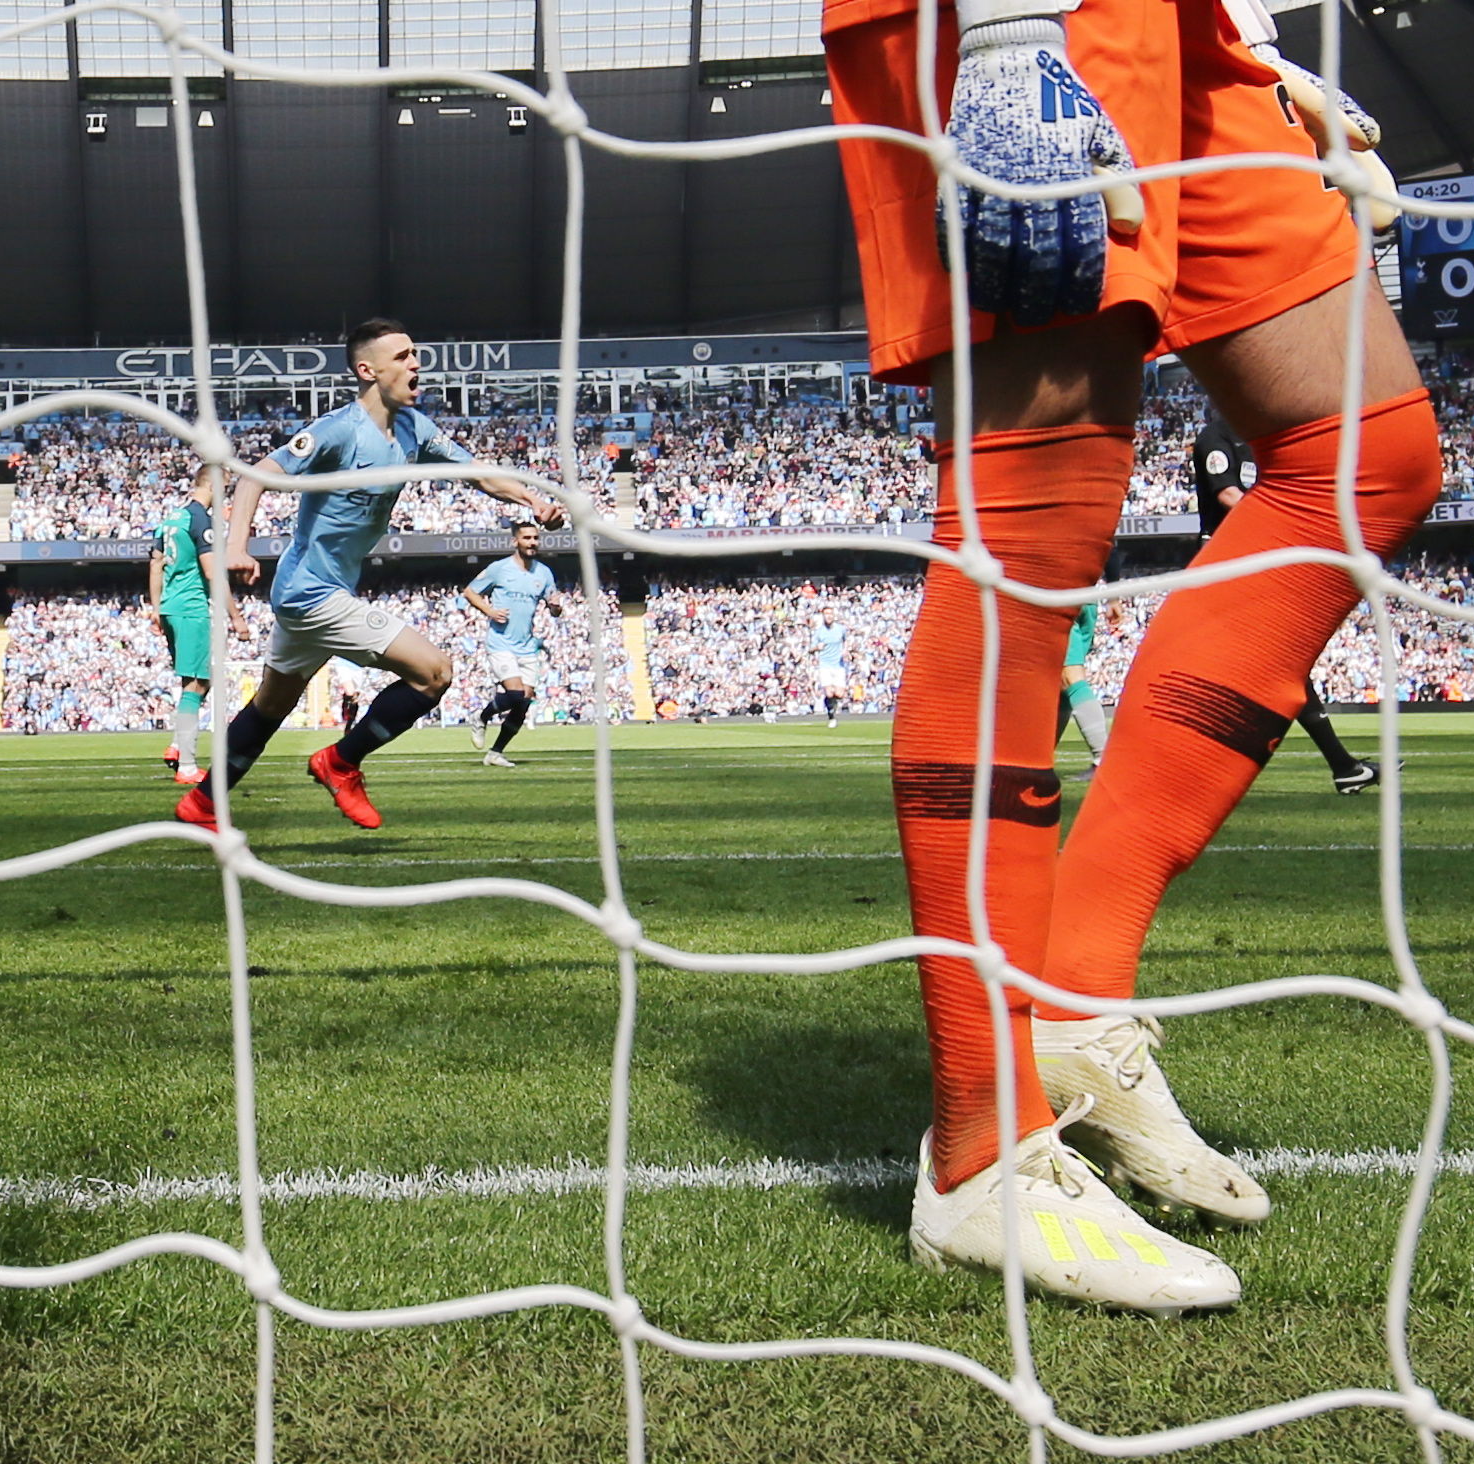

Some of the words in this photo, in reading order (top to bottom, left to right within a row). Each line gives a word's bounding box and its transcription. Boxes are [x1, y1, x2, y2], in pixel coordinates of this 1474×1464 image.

[1413, 182, 1461, 199] 04:20
[115, 347, 327, 376] ETHAD
[444, 535, 517, 550] TOTTENHA
[537, 533, 600, 548] HOTSPR
